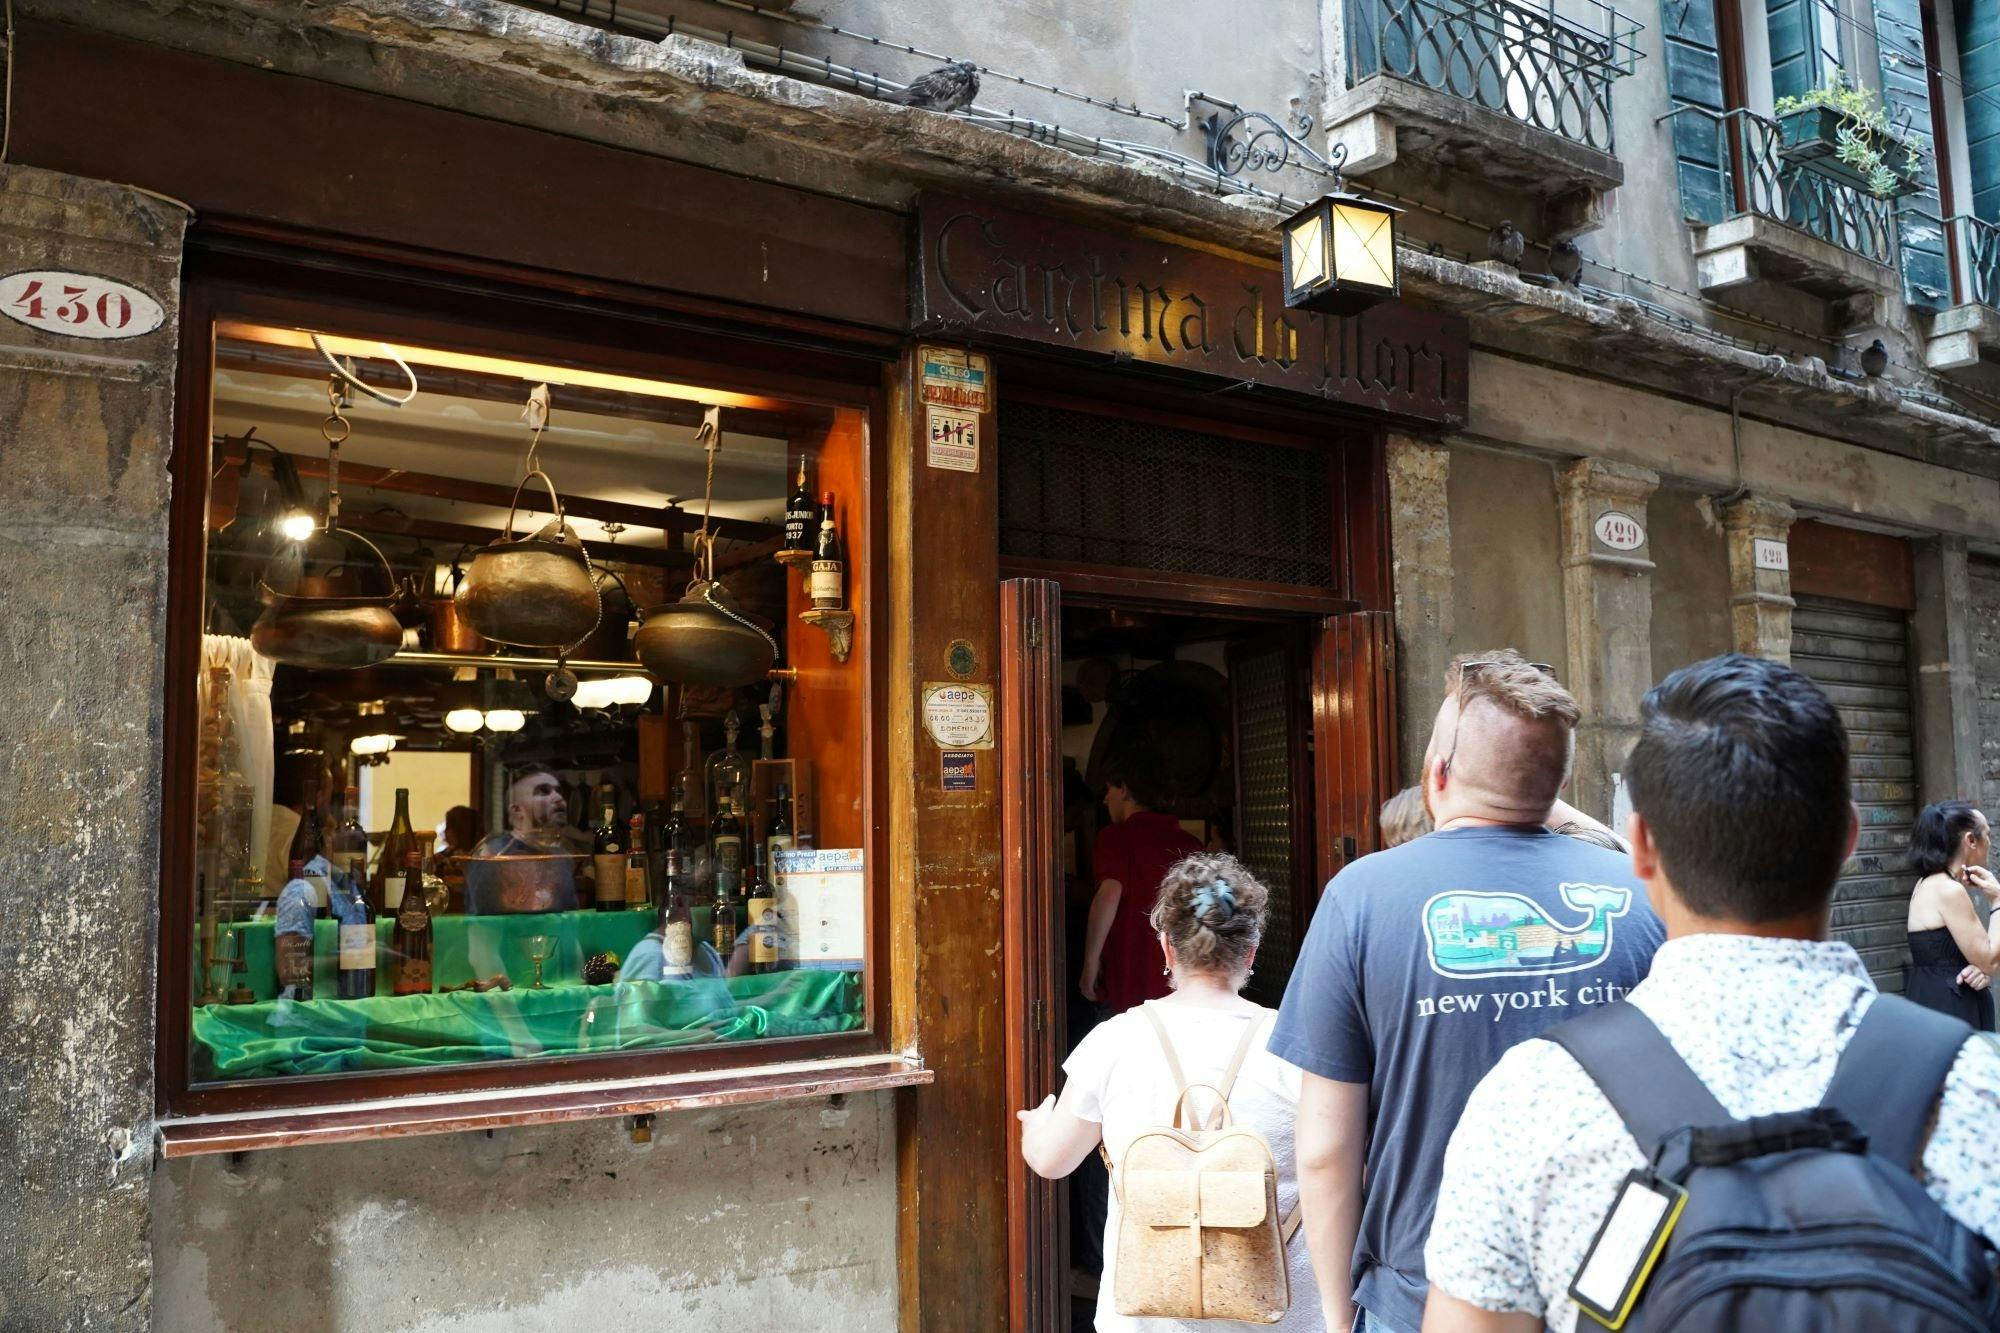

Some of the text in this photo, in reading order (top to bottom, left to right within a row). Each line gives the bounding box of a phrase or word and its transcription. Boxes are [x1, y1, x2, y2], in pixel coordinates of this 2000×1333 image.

[11, 280, 132, 329] 430
[936, 214, 1450, 405] Cantina do Mori
[940, 365, 971, 379] CHIUSO
[1604, 521, 1637, 545] 429
[812, 562, 837, 571] GAJA
[1761, 548, 1782, 564] 428
[1416, 992, 1484, 1018] new
[1491, 978, 1569, 1022] york
